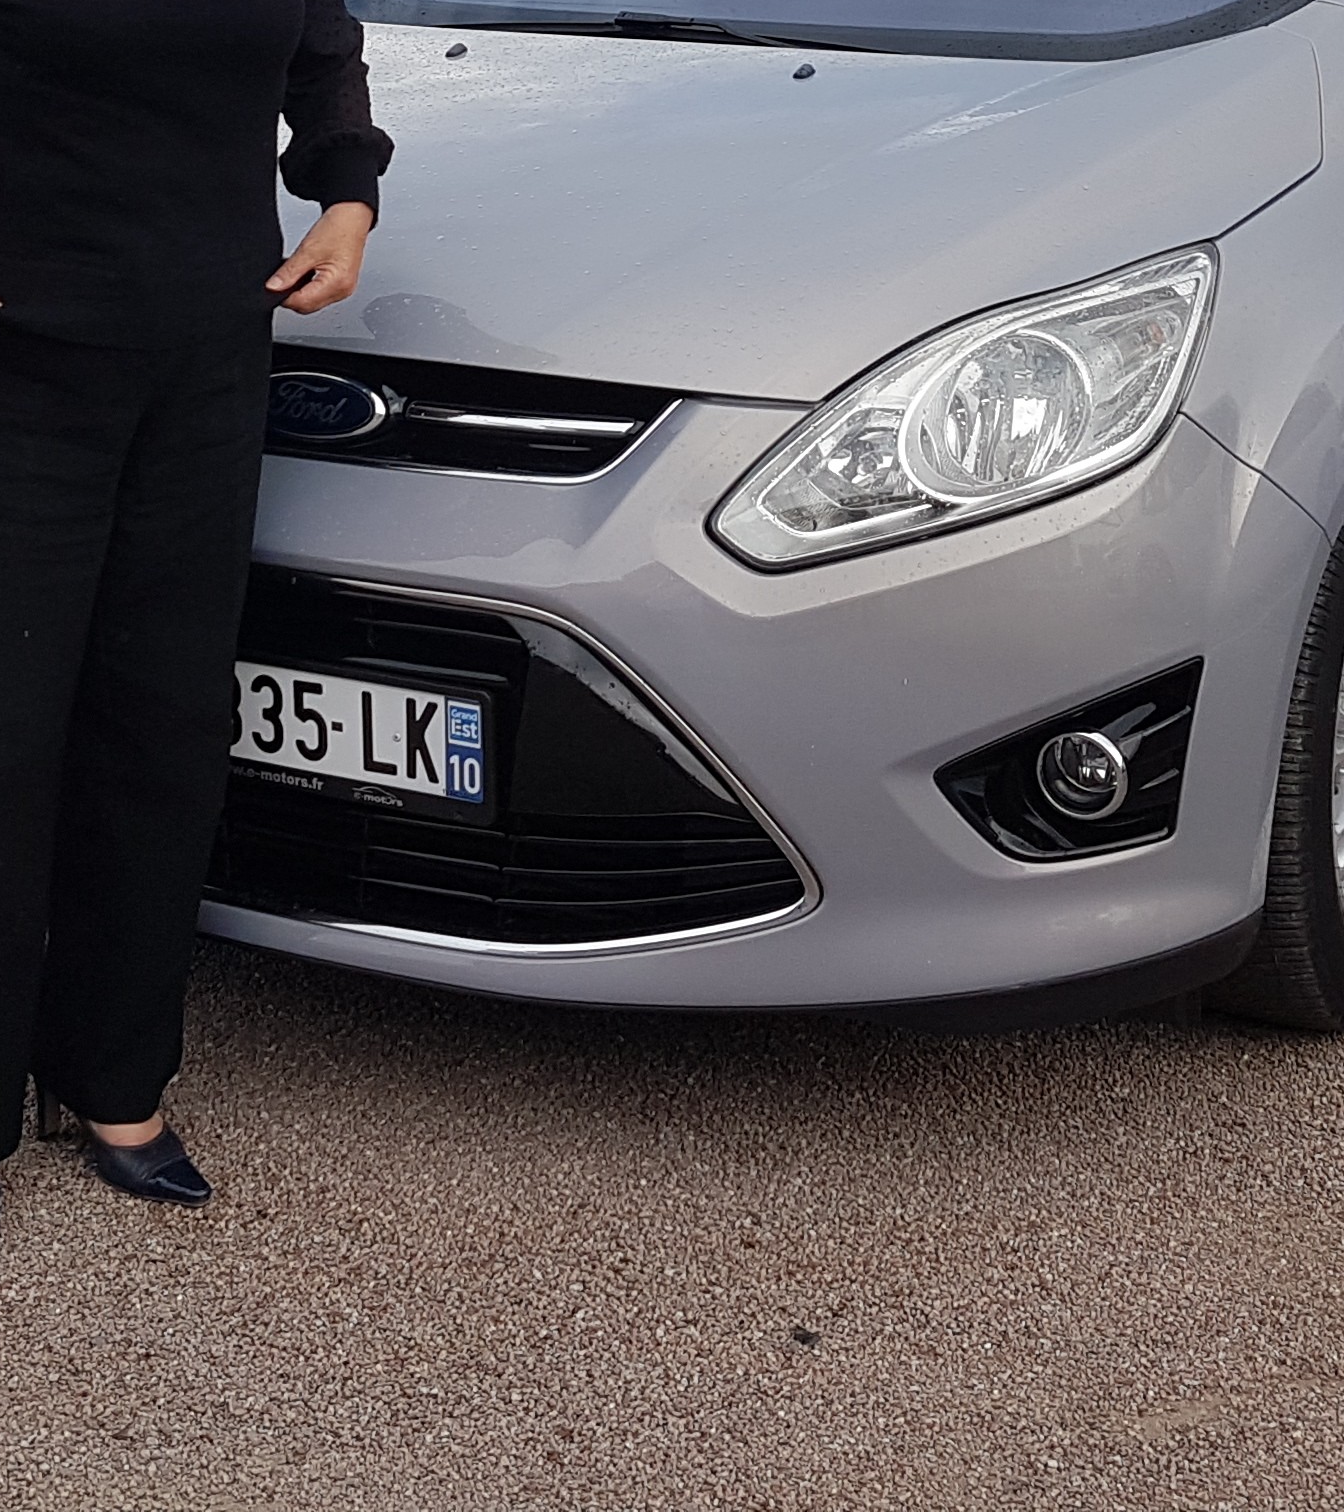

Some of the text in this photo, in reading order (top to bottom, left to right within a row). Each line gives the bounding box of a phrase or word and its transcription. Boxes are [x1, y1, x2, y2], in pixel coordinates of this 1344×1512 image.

[278, 380, 348, 423] Ford
[450, 708, 478, 722] Grand
[451, 718, 478, 739] Est
[449, 754, 481, 795] 10
